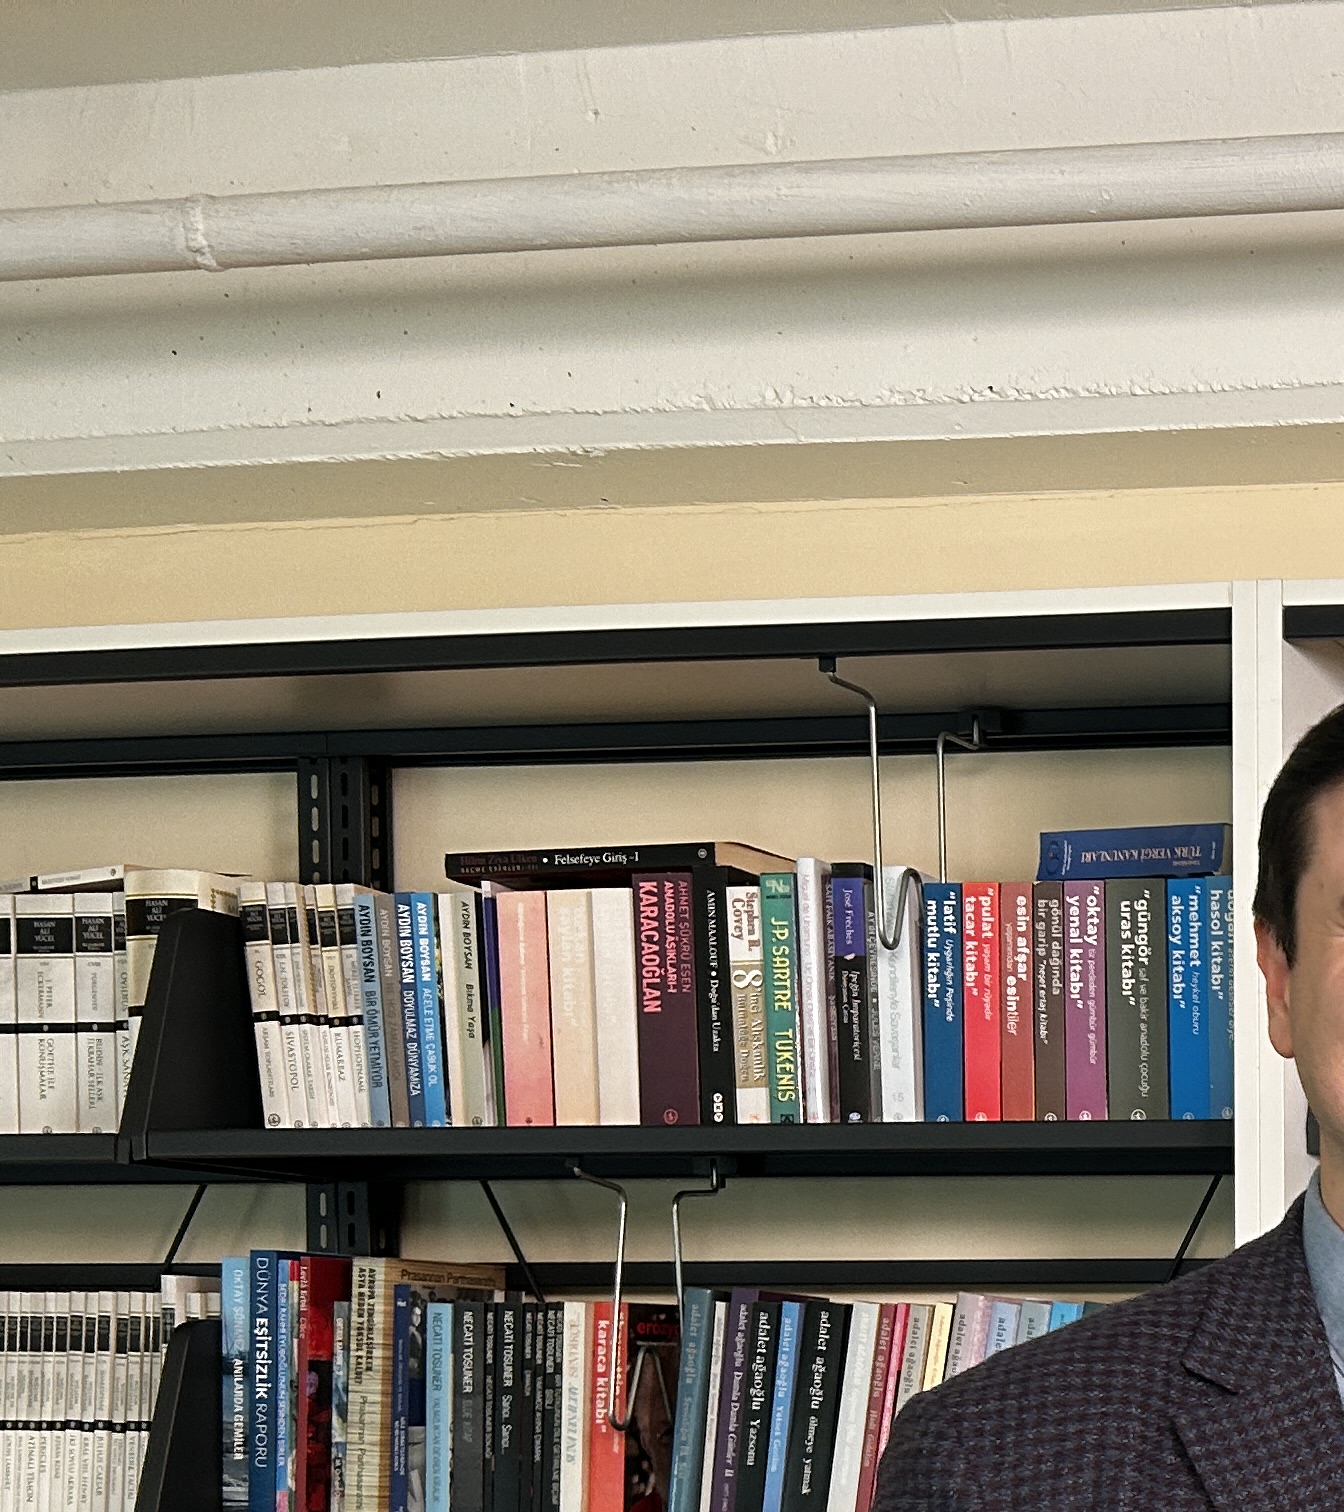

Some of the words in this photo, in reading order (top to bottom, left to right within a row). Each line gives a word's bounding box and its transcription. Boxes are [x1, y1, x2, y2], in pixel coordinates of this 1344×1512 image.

[602, 852, 627, 865] Giriş
[358, 904, 374, 936] AYDIN
[664, 882, 676, 932] ANADOLU
[679, 881, 689, 919] AHMET
[965, 896, 977, 936] tacar
[1017, 896, 1028, 931] esin
[1037, 899, 1048, 918] bir
[1050, 899, 1061, 938] gönül
[1067, 896, 1082, 943] yenal
[1121, 901, 1133, 939] uras
[1169, 895, 1183, 944] aksoy
[1210, 889, 1222, 937] hasol
[927, 900, 940, 946] mutlu
[1035, 921, 1047, 956] garip
[361, 941, 376, 982] BOYSAN
[639, 881, 666, 1012] KARACAOĞLAN
[1015, 936, 1030, 981] afşar
[1050, 941, 1062, 995] dağında
[365, 991, 377, 1007] BİR
[680, 964, 691, 993] ESEN
[772, 946, 791, 1011] SARTRE
[366, 1010, 382, 1038] ÖMÜR
[773, 1029, 796, 1102] TÜKENİŞ
[256, 1257, 271, 1314] DÜNYA
[462, 1311, 475, 1345] NECATİ
[596, 1320, 609, 1373] karaca
[816, 1311, 831, 1351] adalet
[253, 1317, 272, 1399] EŞİTSİZLİK
[462, 1348, 474, 1393] TOSUNER
[810, 1357, 827, 1409] ağaoğlu
[255, 1403, 268, 1468] RAPORU
